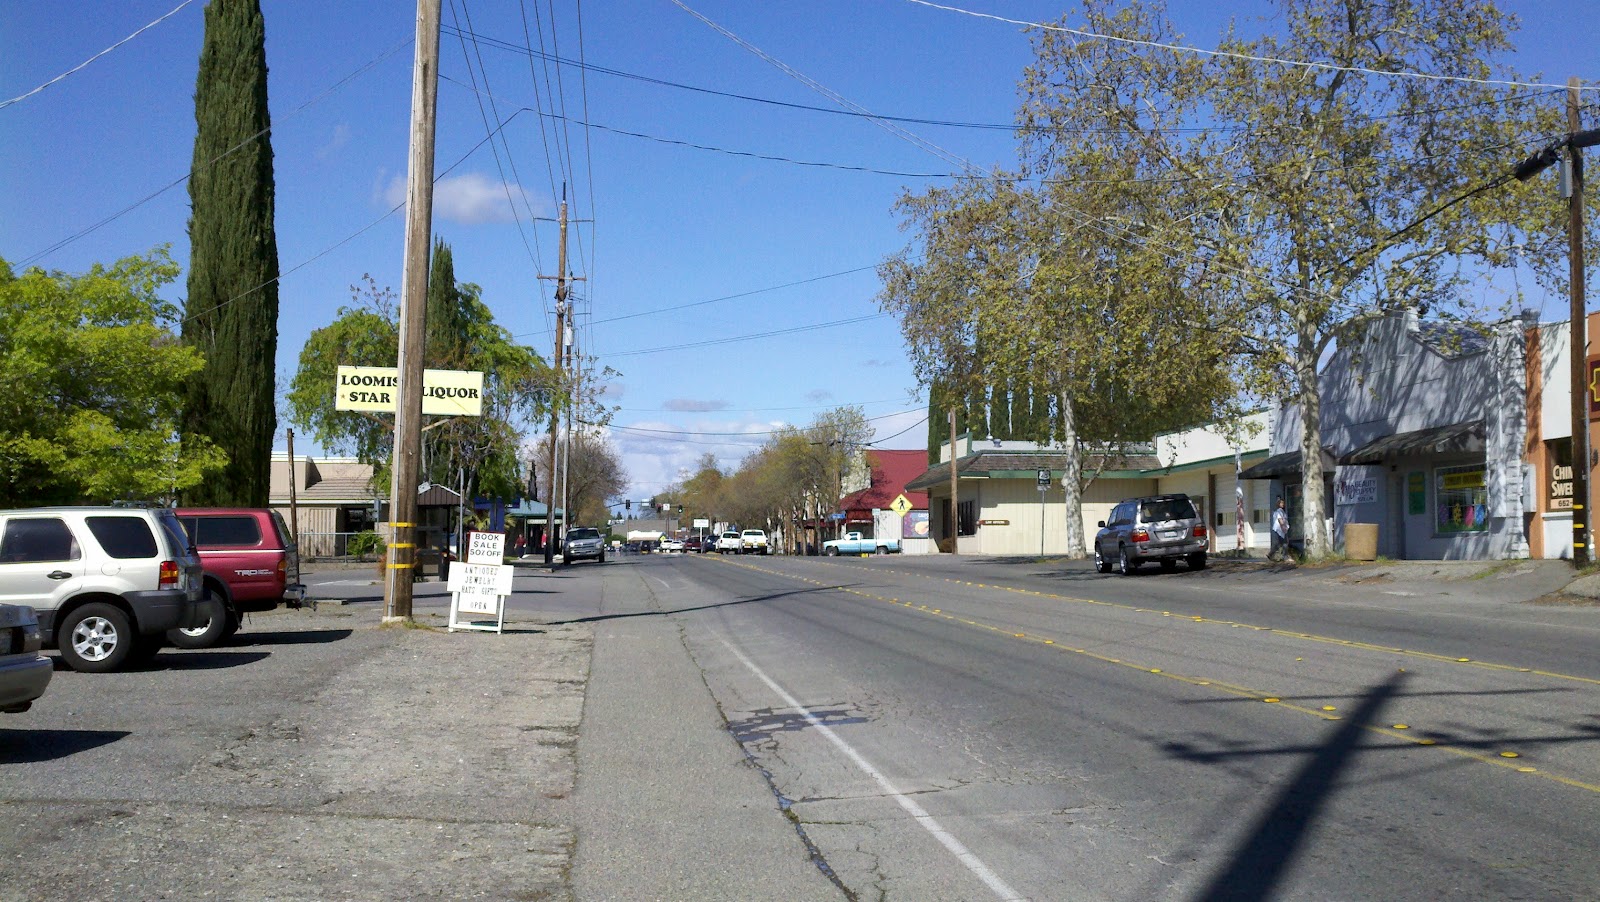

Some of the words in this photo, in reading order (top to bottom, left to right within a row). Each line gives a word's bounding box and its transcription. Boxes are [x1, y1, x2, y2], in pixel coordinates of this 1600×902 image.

[341, 375, 398, 387] LOOMIS
[349, 391, 391, 403] STAR
[423, 387, 479, 399] LIQUOR
[475, 533, 500, 541] BOOK
[473, 541, 497, 549] SALE
